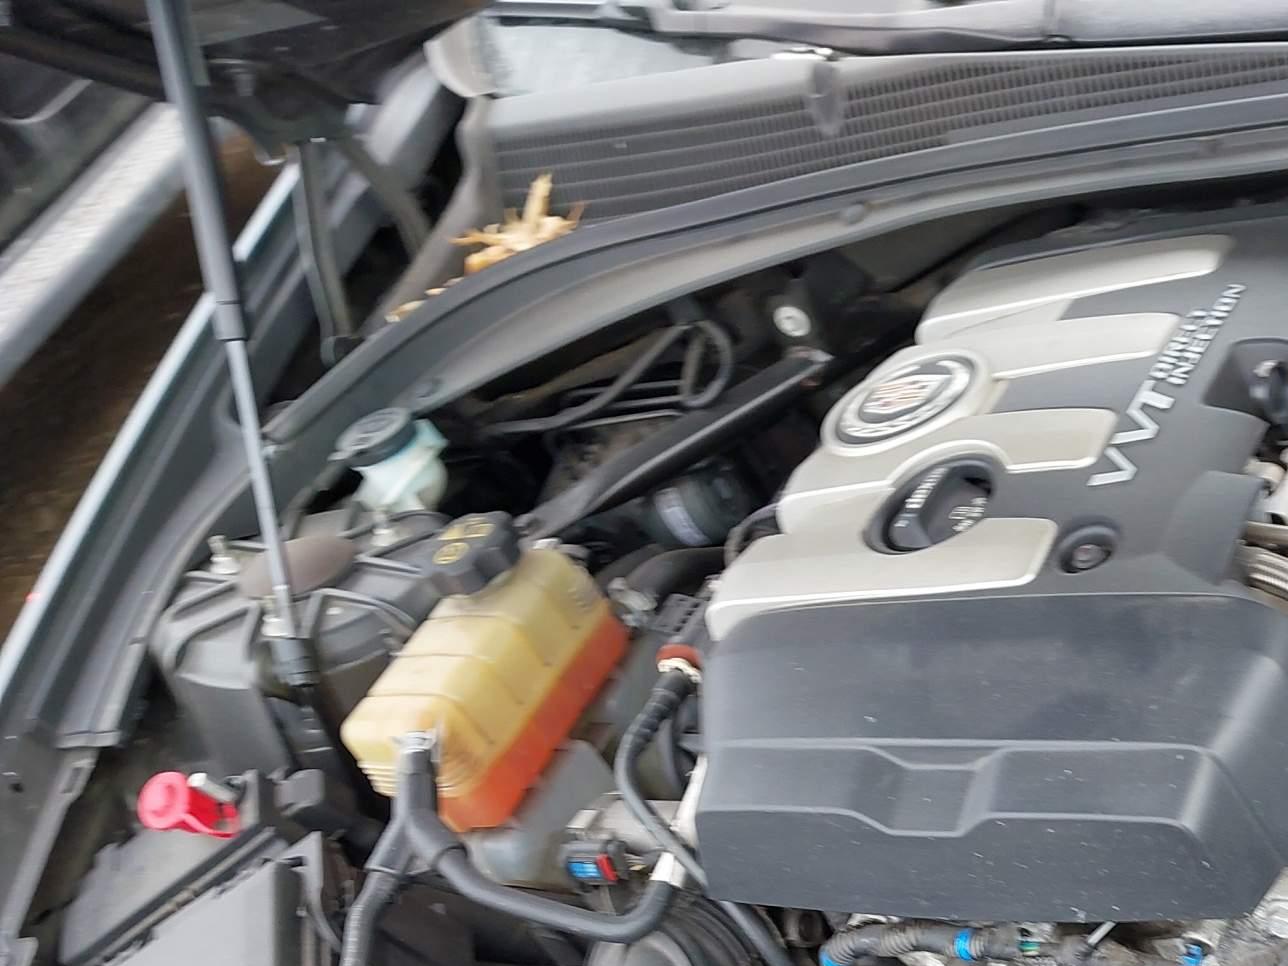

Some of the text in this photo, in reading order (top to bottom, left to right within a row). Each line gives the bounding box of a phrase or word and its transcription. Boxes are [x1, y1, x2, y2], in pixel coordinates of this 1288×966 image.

[1150, 309, 1208, 380] DIRECT
[1166, 283, 1247, 385] INJECTION
[1086, 379, 1176, 486] VVT
